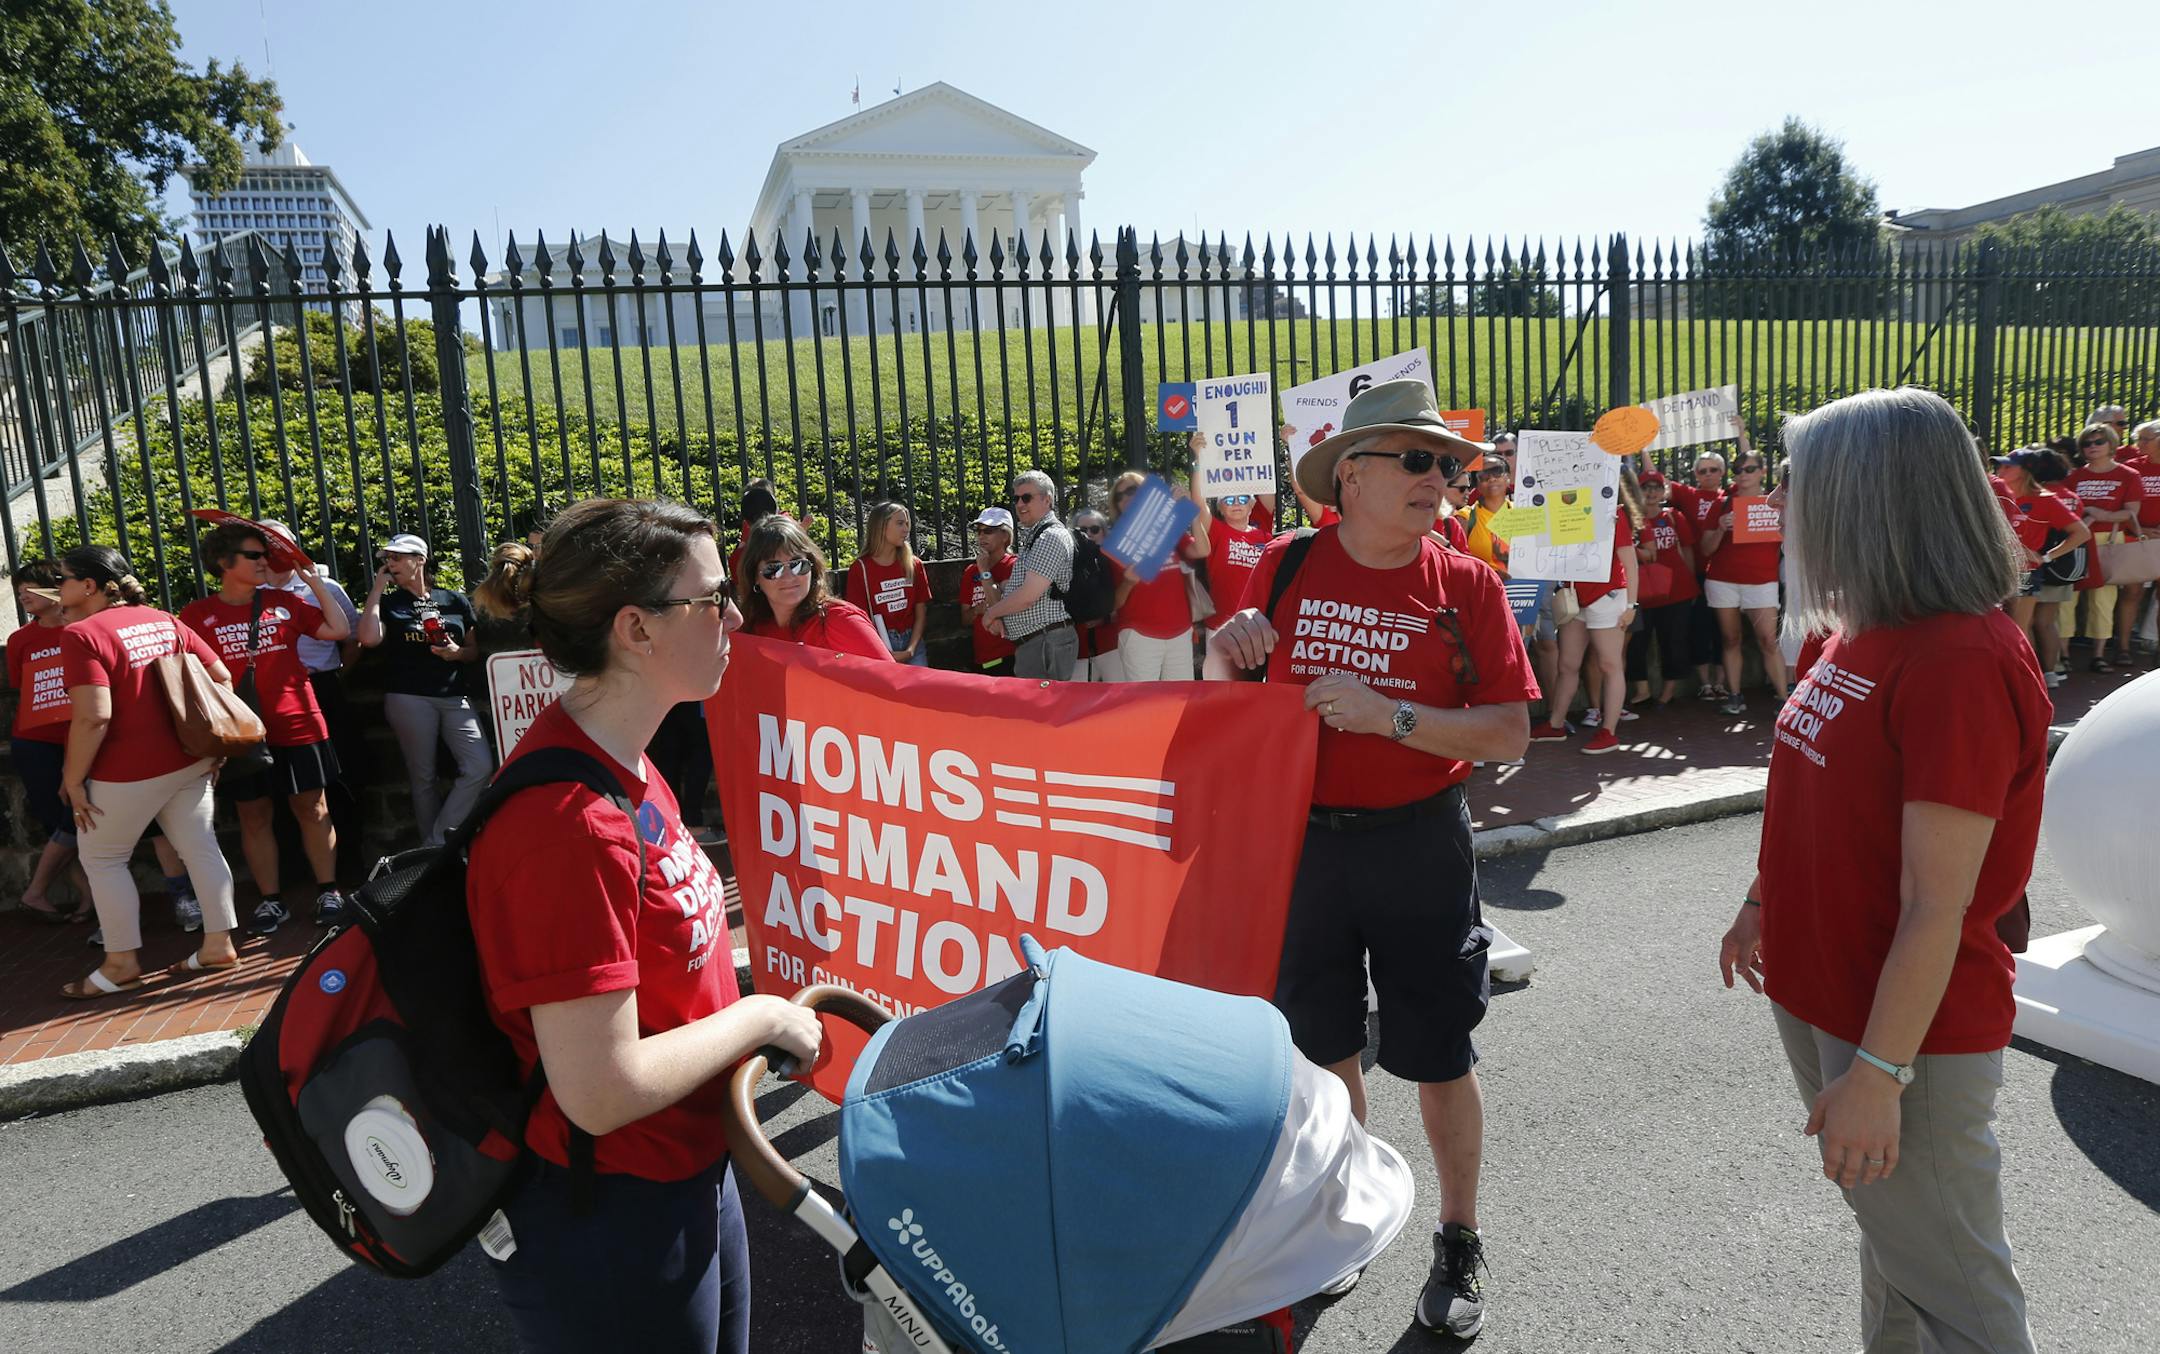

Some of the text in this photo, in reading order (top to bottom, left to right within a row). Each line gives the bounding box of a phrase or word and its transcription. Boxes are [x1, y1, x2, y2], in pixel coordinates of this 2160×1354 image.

[1387, 358, 1422, 382] IENDS
[1296, 397, 1338, 407] FRIENDS
[1663, 393, 1721, 414] DEMAND
[1225, 401, 1239, 428] 1
[1214, 431, 1256, 447] GUN
[1224, 448, 1252, 461] PER
[1206, 464, 1273, 484] MONTH!
[1747, 512, 1780, 520] DEMA
[1747, 519, 1779, 527] ACTIO
[1228, 552, 1260, 565] ACTIO
[1229, 545, 1261, 557] DEMAN
[1298, 598, 1380, 626] MOMS
[116, 622, 158, 640] MOMS
[214, 622, 250, 636] MOM
[217, 625, 277, 645] DEMND
[1294, 618, 1410, 652] DEMAND
[122, 631, 176, 650] DEMAND
[222, 636, 273, 654] ACTON
[31, 647, 61, 661] MOM
[128, 643, 174, 662] ACTION
[1291, 640, 1390, 674] ACTION
[34, 678, 64, 693] DEMA
[518, 661, 554, 690] NO
[1291, 664, 1306, 675] FOR
[1308, 665, 1326, 676] GUN
[1360, 675, 1370, 685] IN
[1372, 677, 1417, 691] AMERICA
[33, 688, 68, 704] ACTIO
[501, 691, 566, 721] PARK
[1779, 702, 1824, 743] TION
[757, 713, 985, 823] MOMS
[758, 792, 1110, 938] DEMAND
[766, 945, 806, 987] FOR
[863, 988, 928, 1020] SEN
[370, 1141, 402, 1182] Wegmans
[884, 1296, 931, 1347] MINU
